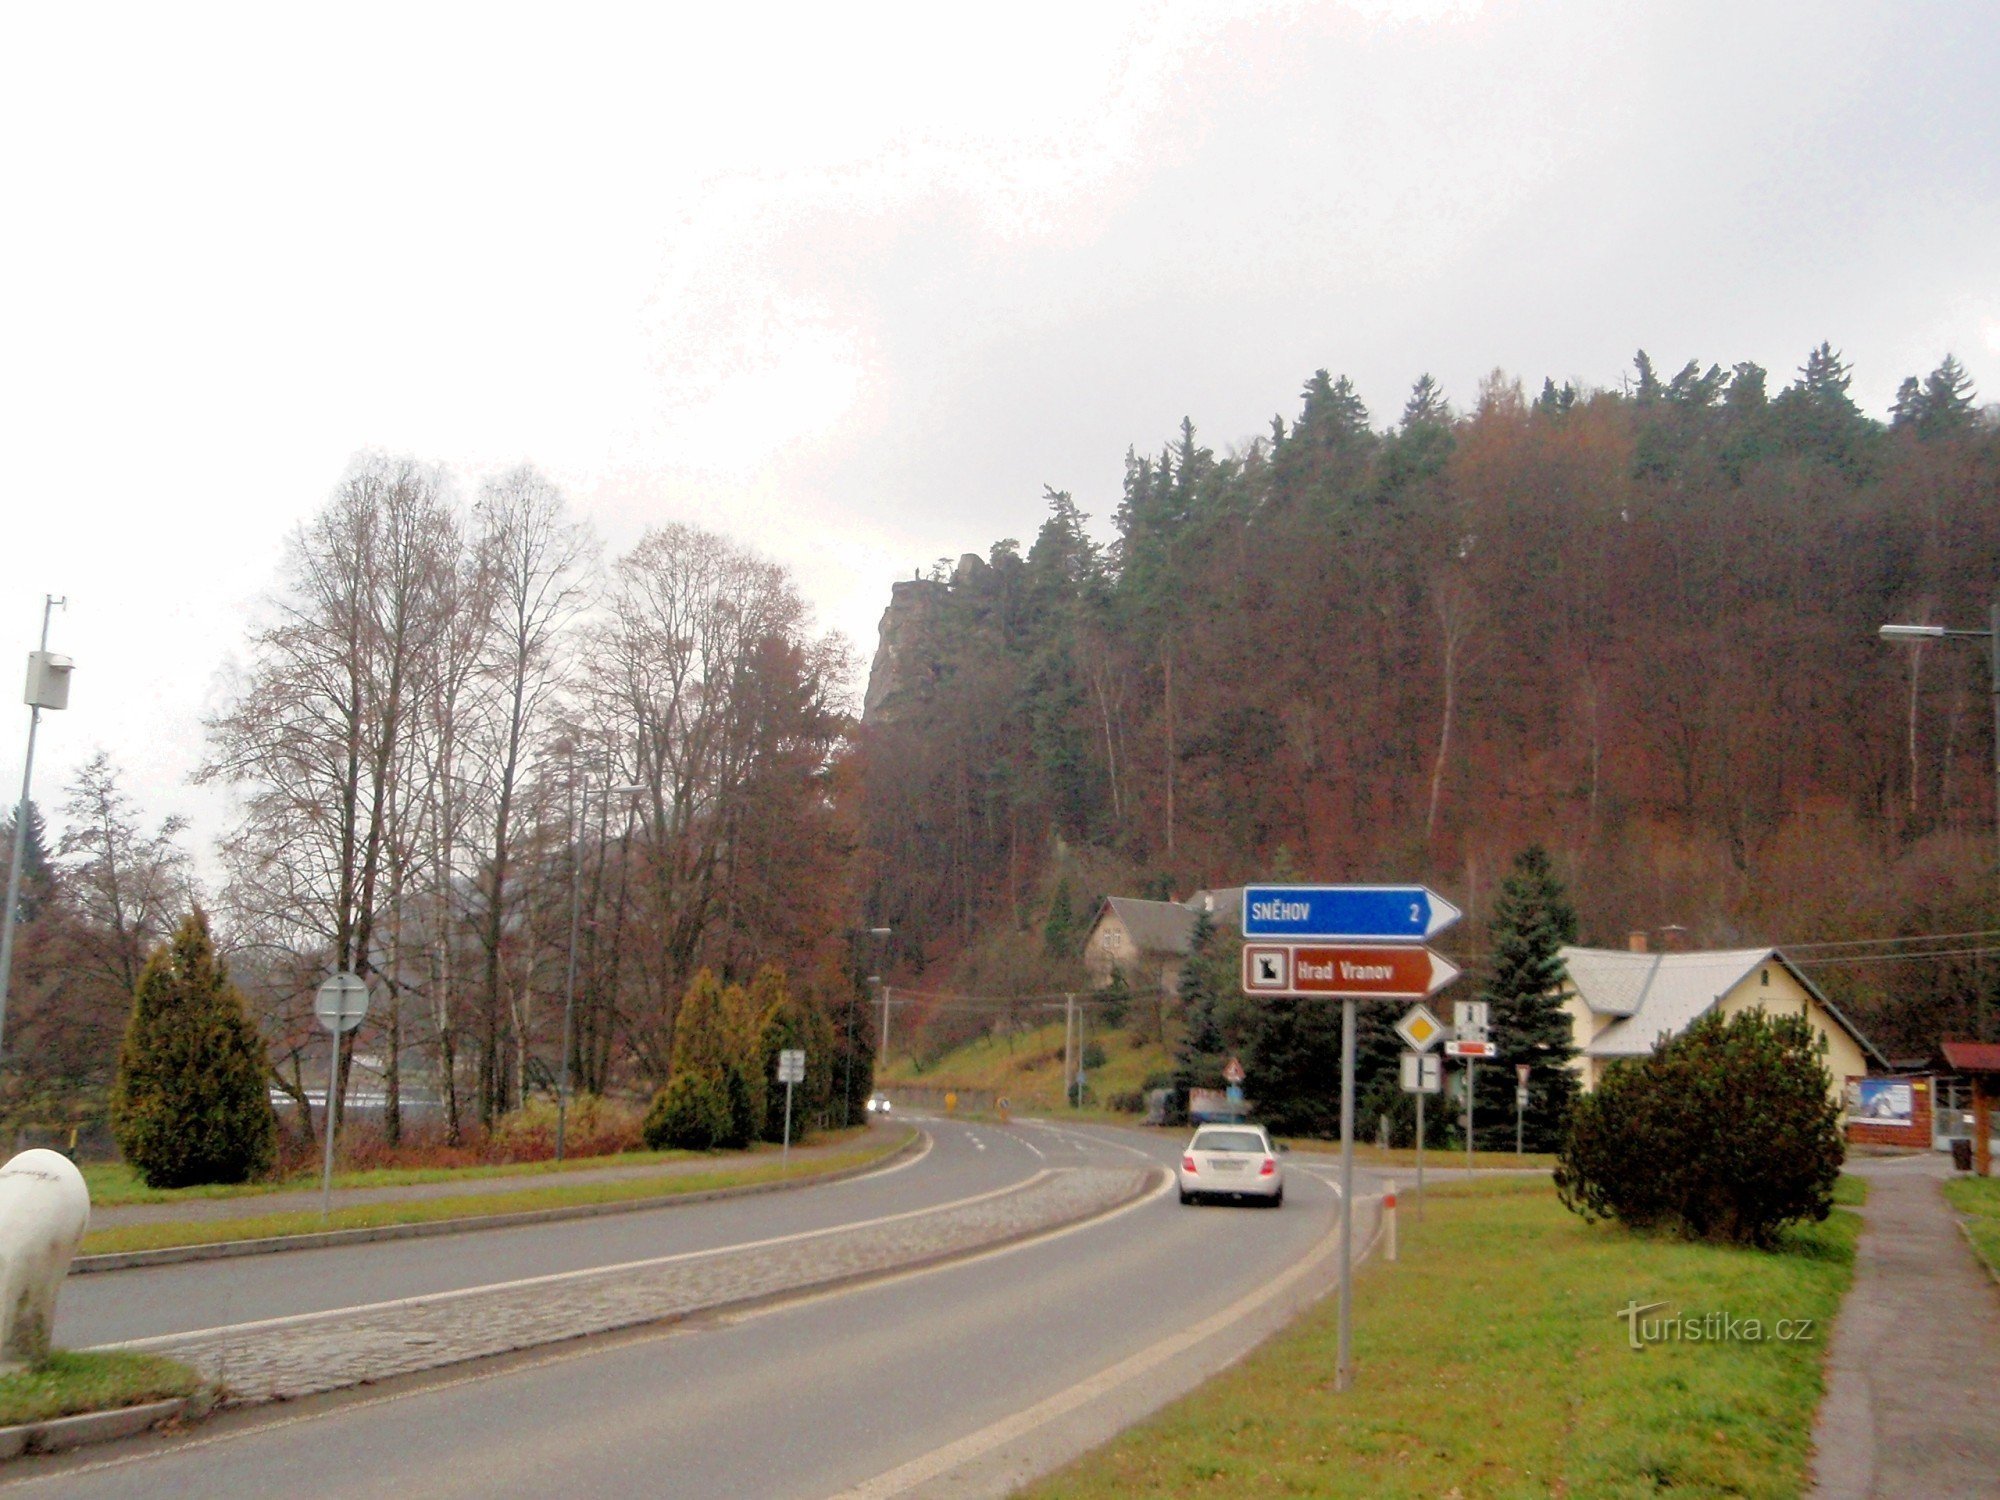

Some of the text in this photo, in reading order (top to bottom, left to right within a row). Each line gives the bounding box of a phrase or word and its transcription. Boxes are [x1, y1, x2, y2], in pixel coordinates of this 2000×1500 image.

[1252, 898, 1420, 922] SNĚHOV 2
[1298, 961, 1394, 980] Hrad Vranov
